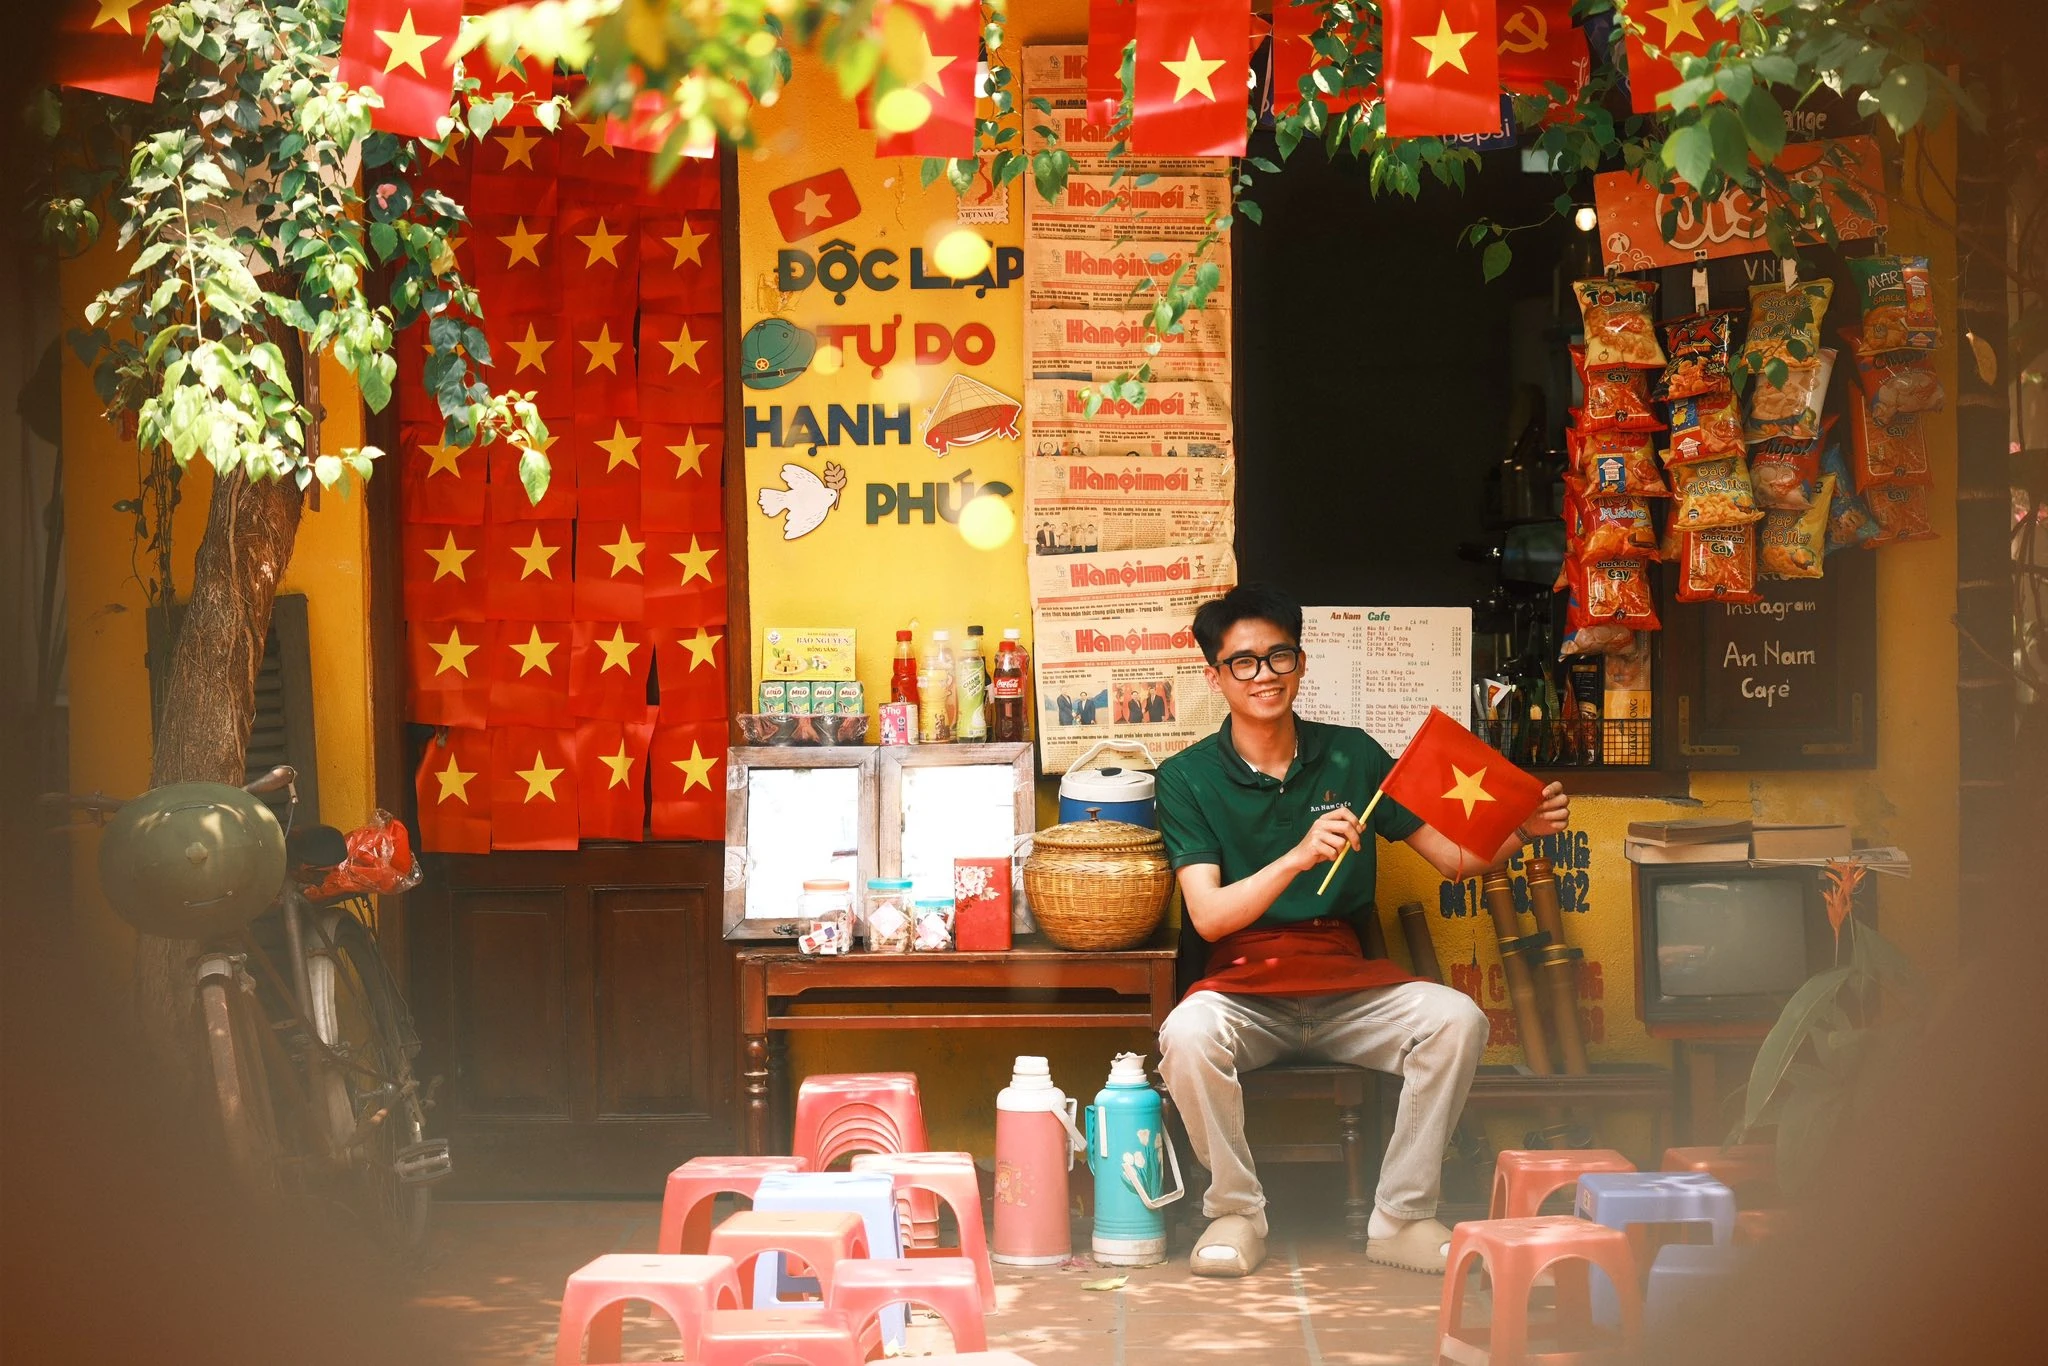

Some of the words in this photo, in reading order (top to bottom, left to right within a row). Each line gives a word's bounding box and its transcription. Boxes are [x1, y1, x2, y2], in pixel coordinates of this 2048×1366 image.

[773, 238, 900, 306] ĐỘC
[1744, 260, 1783, 282] VN
[1868, 270, 1904, 296] MAR
[816, 314, 902, 380] TỰ
[914, 323, 995, 366] DO
[1066, 319, 1184, 347] Hànộii
[1067, 389, 1184, 418] Hnmới
[744, 404, 911, 457] HẠNH
[1069, 466, 1188, 493] Hànộimới
[1710, 543, 1734, 557] Cay
[1070, 556, 1191, 588] Hànộimới
[1607, 568, 1630, 581] Cay
[1330, 612, 1341, 620] An
[1342, 612, 1361, 620] Nam
[1368, 611, 1390, 621] Cafe
[1726, 601, 1816, 620] Instagram
[1076, 626, 1196, 655] Hànộimới
[1723, 641, 1758, 668] An
[1764, 640, 1816, 665] Nam
[1741, 678, 1791, 708] Café
